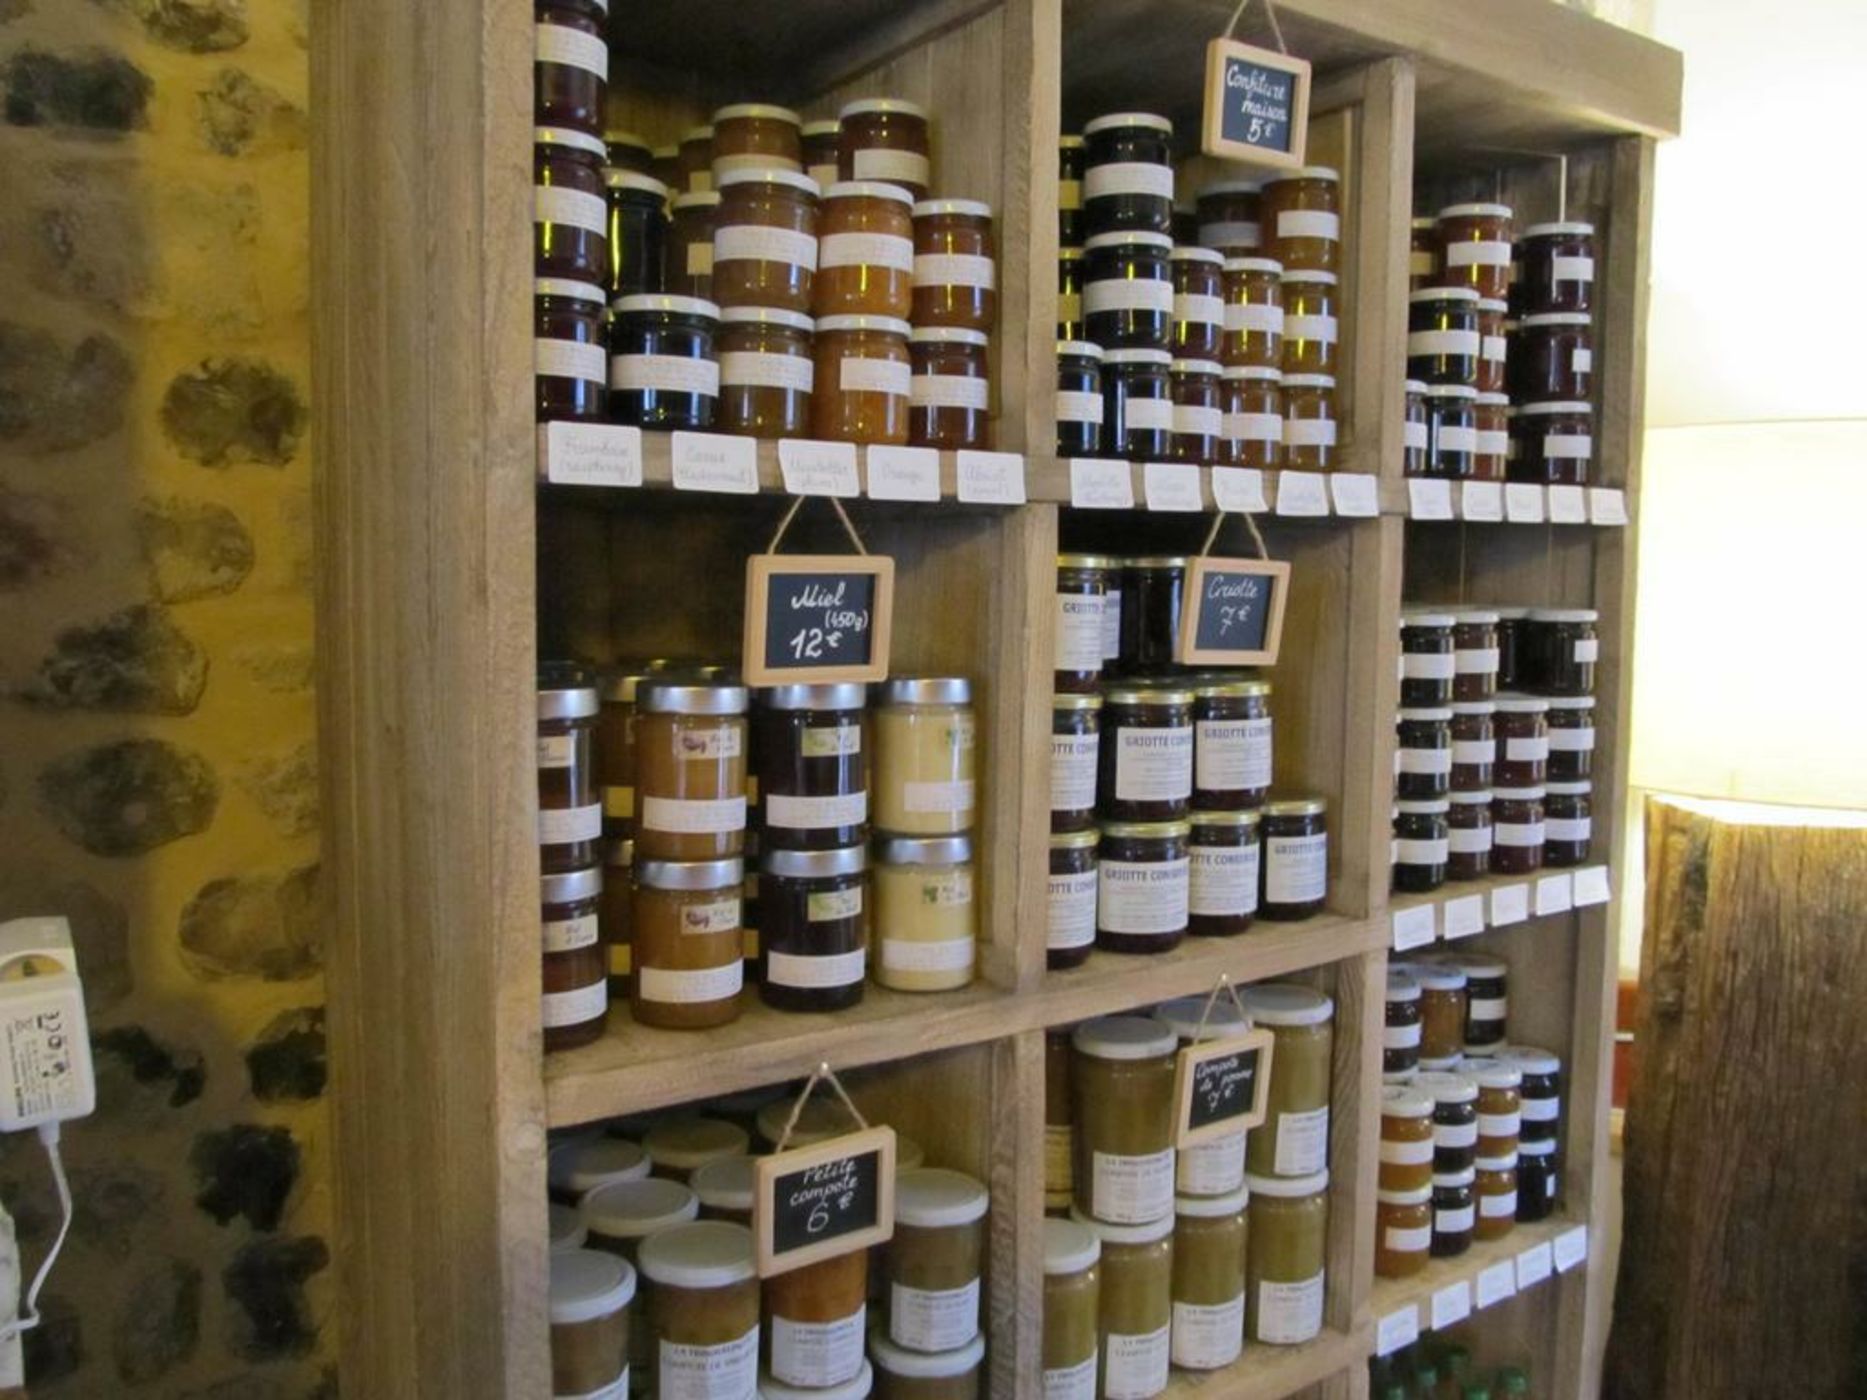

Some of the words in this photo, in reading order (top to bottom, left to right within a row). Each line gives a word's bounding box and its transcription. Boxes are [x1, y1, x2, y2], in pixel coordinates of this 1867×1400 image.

[1226, 63, 1285, 101] Confiture
[1240, 98, 1288, 122] maison
[790, 580, 847, 610] Miel
[789, 626, 844, 660] 12€
[789, 1175, 860, 1207] compote
